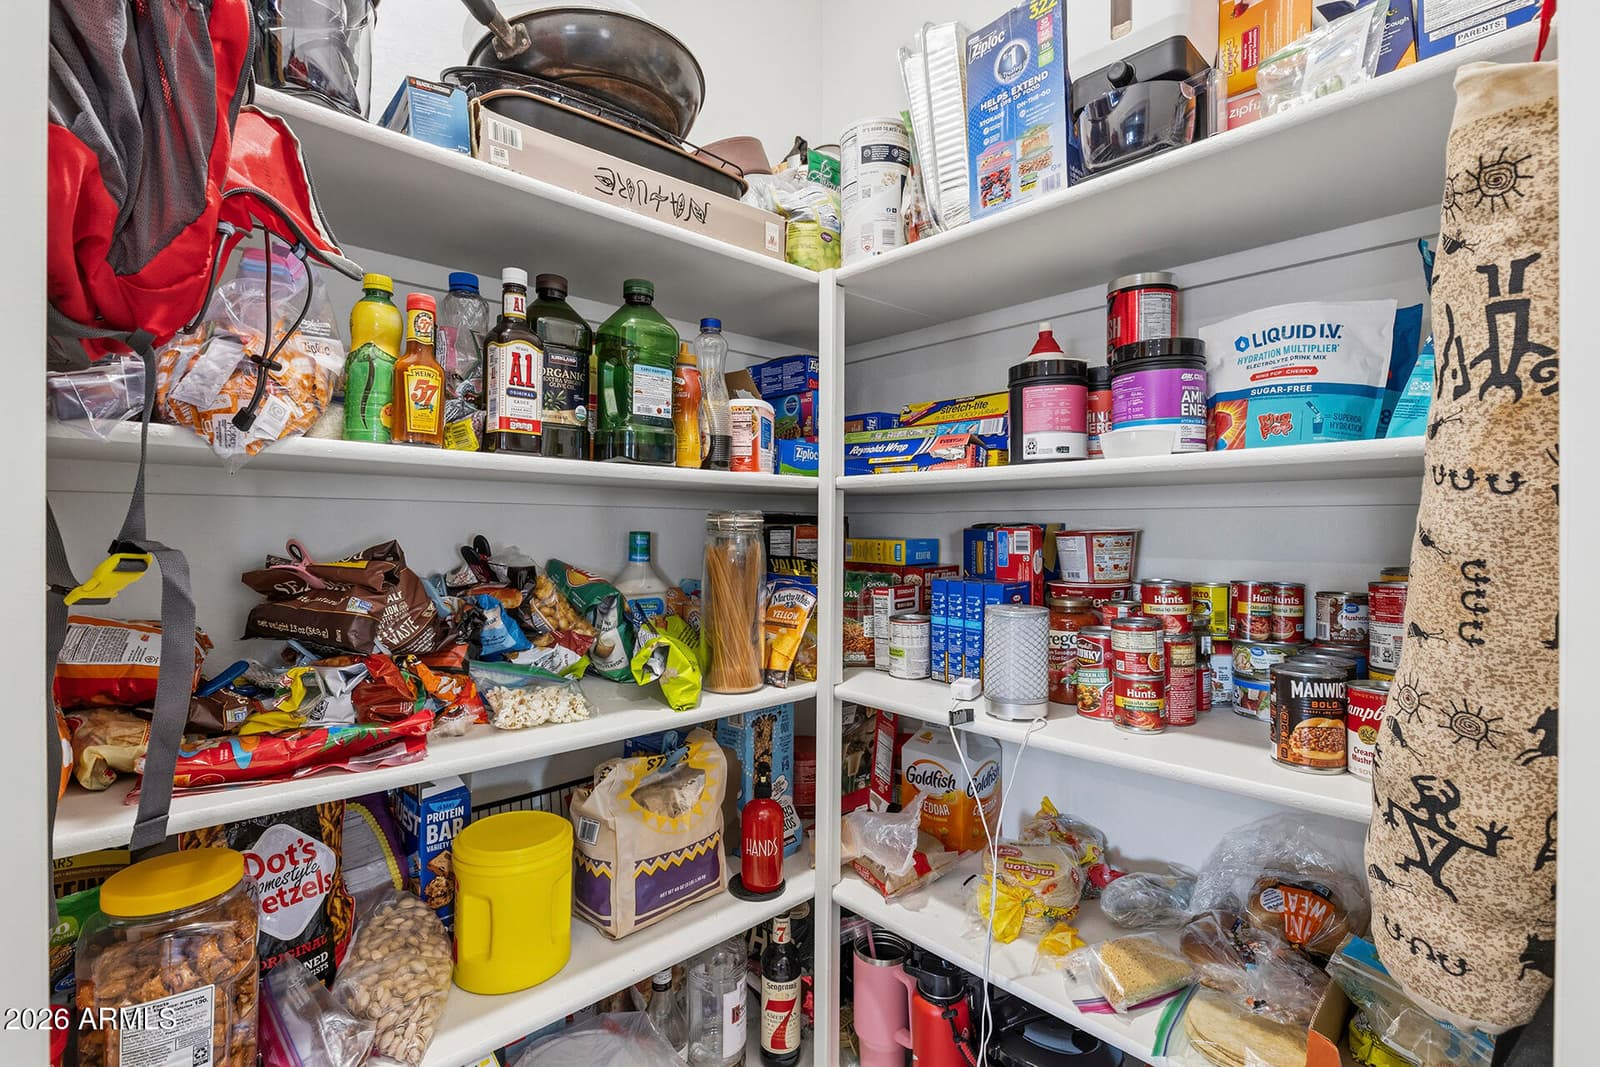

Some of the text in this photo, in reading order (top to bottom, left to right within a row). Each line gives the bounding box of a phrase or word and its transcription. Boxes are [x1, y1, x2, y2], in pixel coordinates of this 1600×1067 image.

[1457, 20, 1505, 42] PARENTS:
[970, 30, 1006, 59] Ziploc
[980, 70, 1049, 111] HELPS EXTEND
[1252, 324, 1317, 348] LIQUID
[1236, 343, 1340, 366] HYDRATION MULTIPLIER
[1246, 356, 1288, 370] ELECTROLYTE
[509, 351, 535, 389] A1
[543, 367, 586, 382] ORGANIC
[411, 379, 438, 405] 57
[1250, 384, 1313, 396] SUGAR-FREE
[940, 400, 989, 415] stretch-tite
[795, 447, 819, 463] Ziploc
[850, 442, 908, 457] Reynolds Wrap
[387, 616, 419, 646] WASTE
[1049, 633, 1078, 649] rego
[1290, 680, 1346, 699] MANWIC
[1311, 701, 1338, 709] BOLD
[1352, 753, 1372, 765] Mushr
[906, 765, 956, 789] Goldfish
[426, 805, 465, 824] PROTEIN
[426, 841, 450, 853] VARIETY
[746, 838, 778, 857] HANDS
[243, 838, 317, 880] Dot's
[261, 869, 332, 914] etzels
[304, 951, 329, 970] NED
[765, 998, 797, 1050] 7
